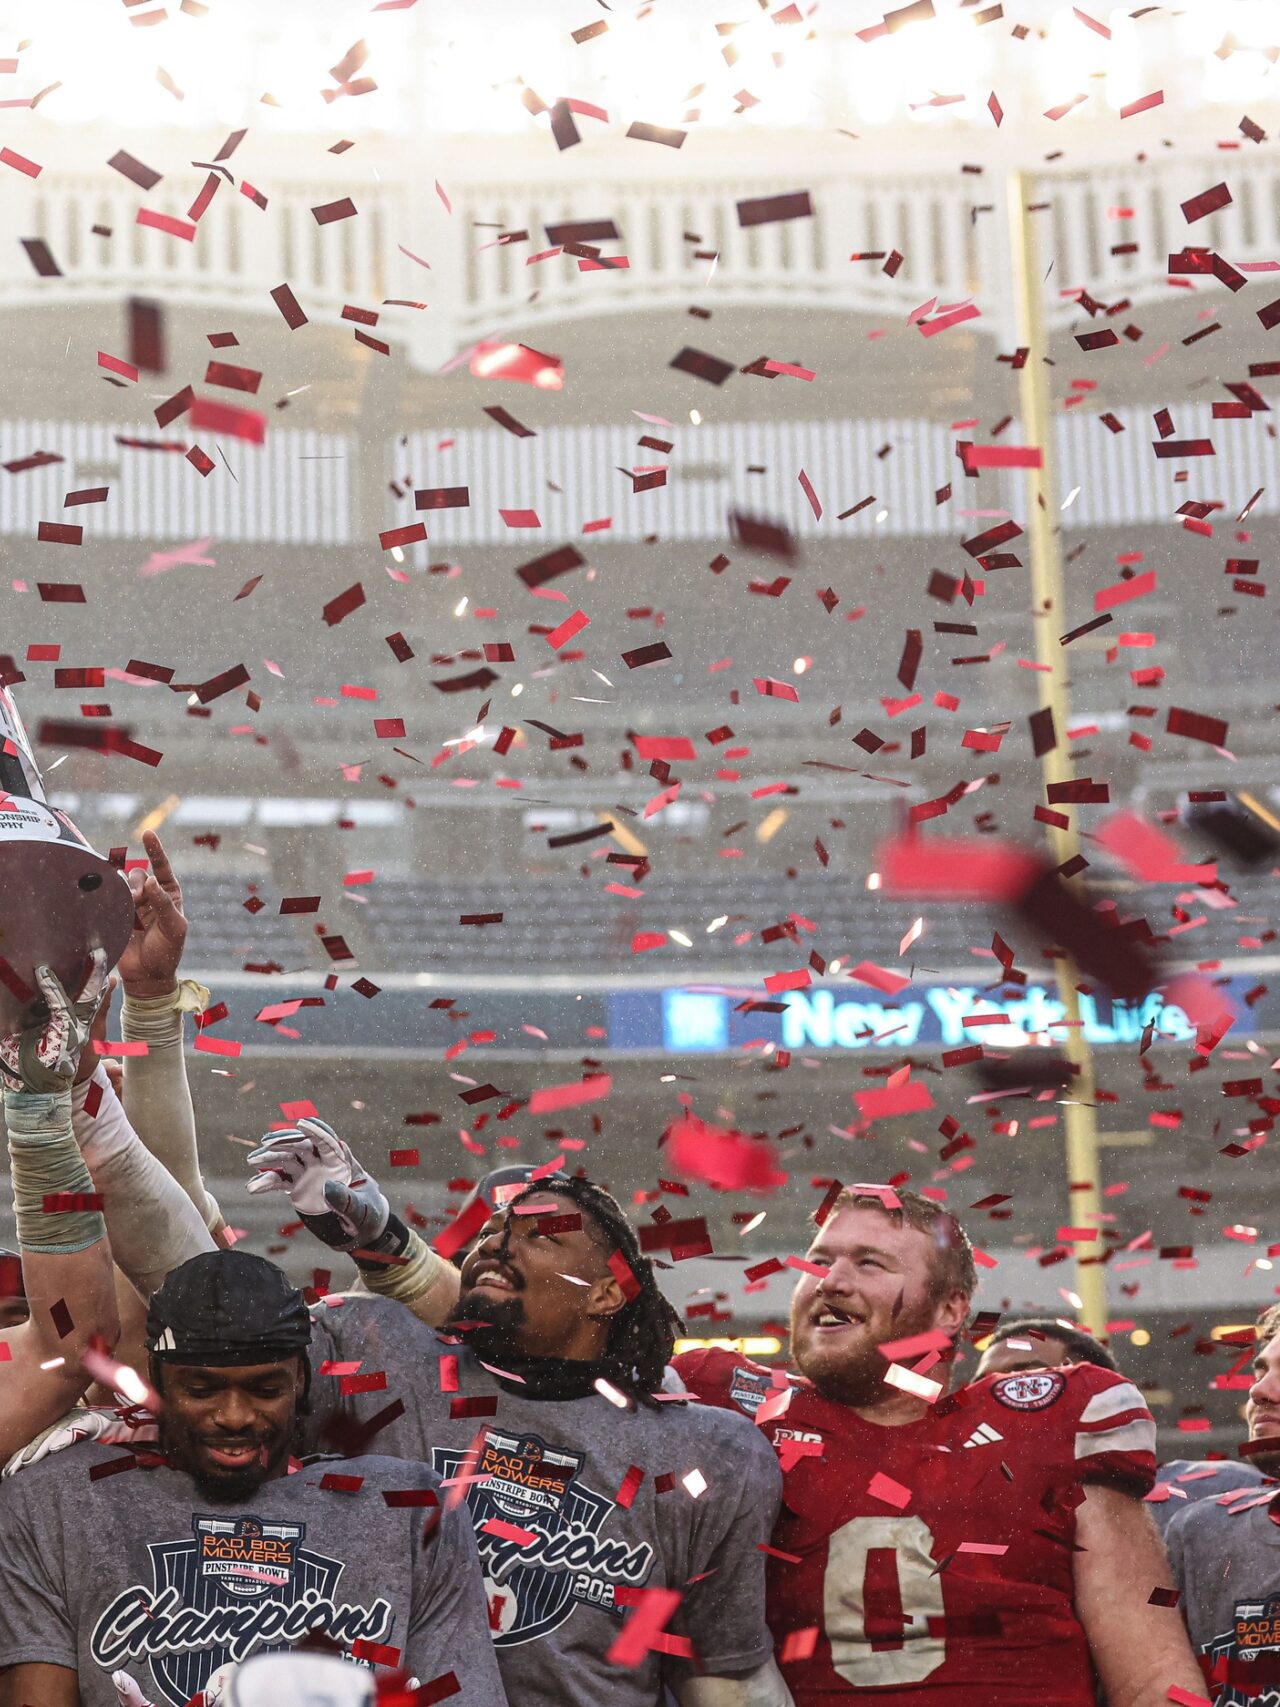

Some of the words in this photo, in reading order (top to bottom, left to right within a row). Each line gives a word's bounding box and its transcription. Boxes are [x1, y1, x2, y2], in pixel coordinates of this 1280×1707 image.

[781, 988, 923, 1048] New
[485, 1449, 523, 1471] BAD
[481, 1460, 566, 1495] MOWERS
[481, 1477, 528, 1499] PINSTRIPE
[203, 1535, 244, 1549] BAD
[251, 1538, 292, 1552] BOY
[203, 1545, 292, 1564] MOWERS
[205, 1562, 255, 1574] PINSTRIPE
[258, 1566, 287, 1580] BOWL
[572, 1574, 619, 1609] 202
[823, 1515, 946, 1688] 0
[90, 1584, 393, 1667] Champions
[1237, 1620, 1270, 1633] BAD
